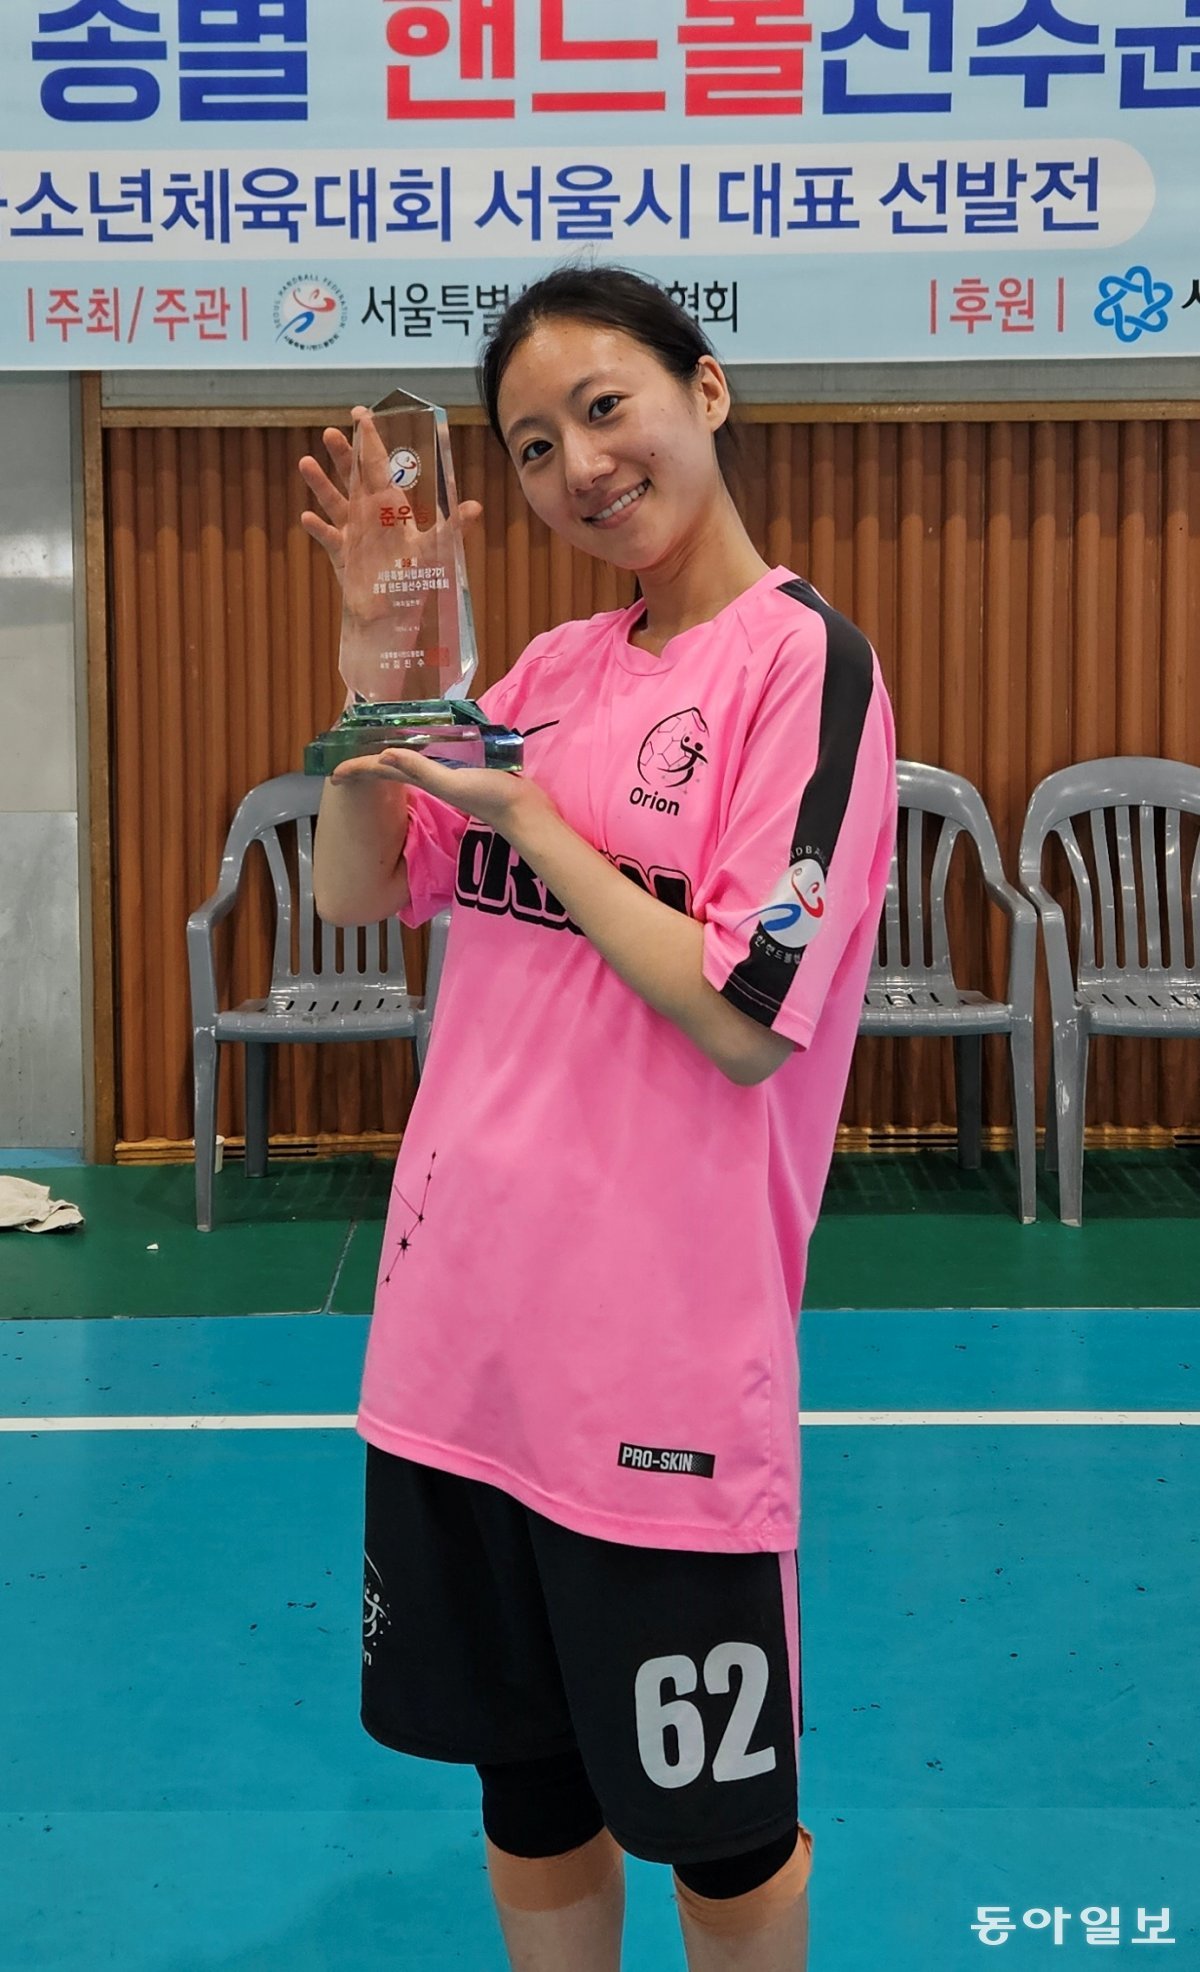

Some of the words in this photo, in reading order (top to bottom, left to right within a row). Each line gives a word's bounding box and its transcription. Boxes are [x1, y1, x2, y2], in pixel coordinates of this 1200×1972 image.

[0, 167, 452, 244] 소년체육대회
[475, 164, 690, 242] 서울시
[717, 162, 861, 239] 대표
[879, 157, 1100, 235] 선발전
[629, 786, 680, 816] Orion
[621, 1445, 693, 1472] PRO-SKIN
[634, 1641, 777, 1789] 62
